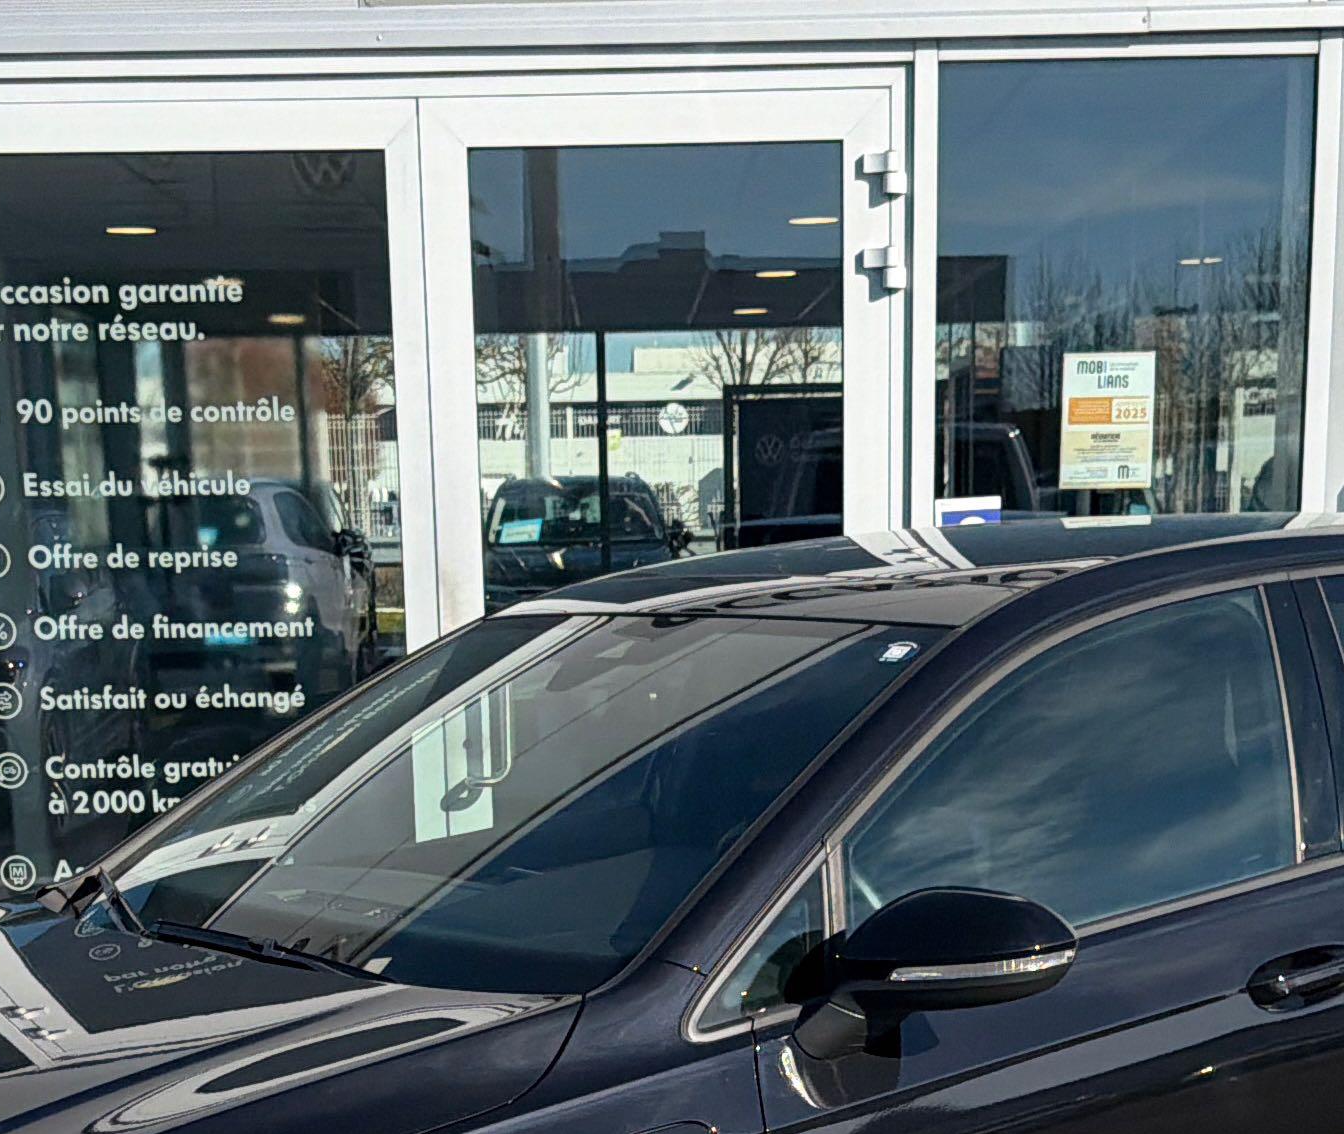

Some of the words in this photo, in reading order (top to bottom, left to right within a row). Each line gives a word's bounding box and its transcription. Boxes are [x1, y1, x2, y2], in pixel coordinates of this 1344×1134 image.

[119, 276, 244, 310] garantie
[13, 318, 89, 342] notre
[99, 314, 206, 342] réseau.
[1077, 360, 1107, 374] MOBI
[1097, 374, 1129, 389] LIANS
[16, 400, 53, 424] 90
[62, 400, 142, 429] points
[149, 399, 182, 423] de
[191, 397, 296, 423] contrôle
[1115, 408, 1147, 419] 2025
[23, 474, 91, 498] Essai
[99, 471, 133, 497] du
[141, 470, 251, 497] véhicule
[28, 545, 101, 570] Offre
[108, 545, 140, 570] de
[148, 544, 238, 575] reprise
[34, 615, 104, 641] Offre
[112, 615, 145, 640] de
[153, 613, 314, 640] financement
[40, 685, 146, 711] Satisfait
[154, 690, 188, 709] ou
[195, 683, 305, 714] échangé
[45, 754, 155, 779] Contrôle
[48, 791, 67, 814] à
